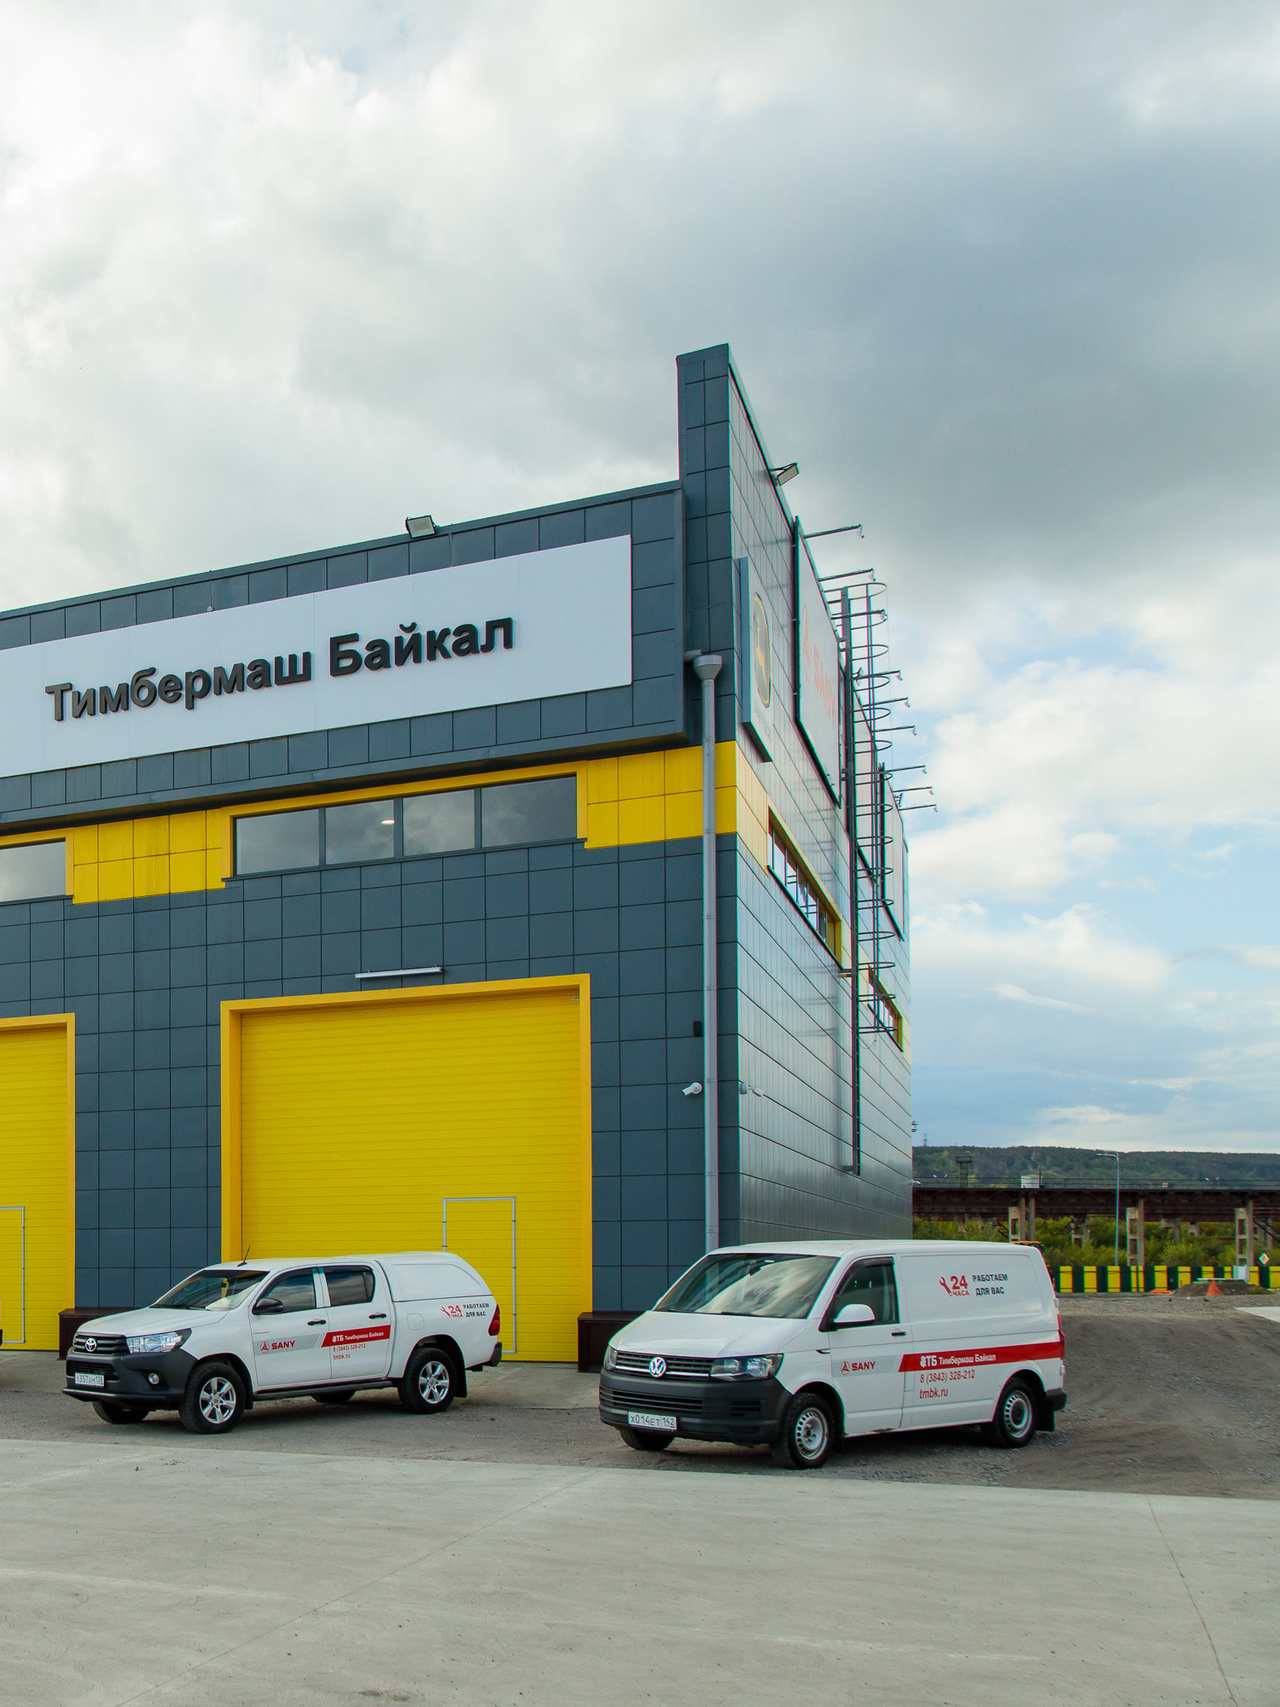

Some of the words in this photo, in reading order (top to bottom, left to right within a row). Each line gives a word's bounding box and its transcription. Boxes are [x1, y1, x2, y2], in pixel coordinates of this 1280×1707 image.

[45, 651, 312, 722] Тимбермаш
[329, 616, 514, 677] Байкал
[950, 1275, 968, 1290] 24
[972, 1273, 1009, 1282] РАБОТАЕМ
[975, 1287, 990, 1297] ДЛЯ
[990, 1286, 1005, 1295] ВАС
[448, 1305, 461, 1313] 24
[271, 1339, 296, 1350] SANY
[938, 1355, 974, 1366] Тимбермаш
[974, 1353, 997, 1363] Байкал
[851, 1361, 877, 1371] SANY
[919, 1373, 925, 1383] 8
[926, 1371, 948, 1385] (3843)
[948, 1369, 976, 1381] 328-212
[919, 1387, 949, 1399] tmbk.ru
